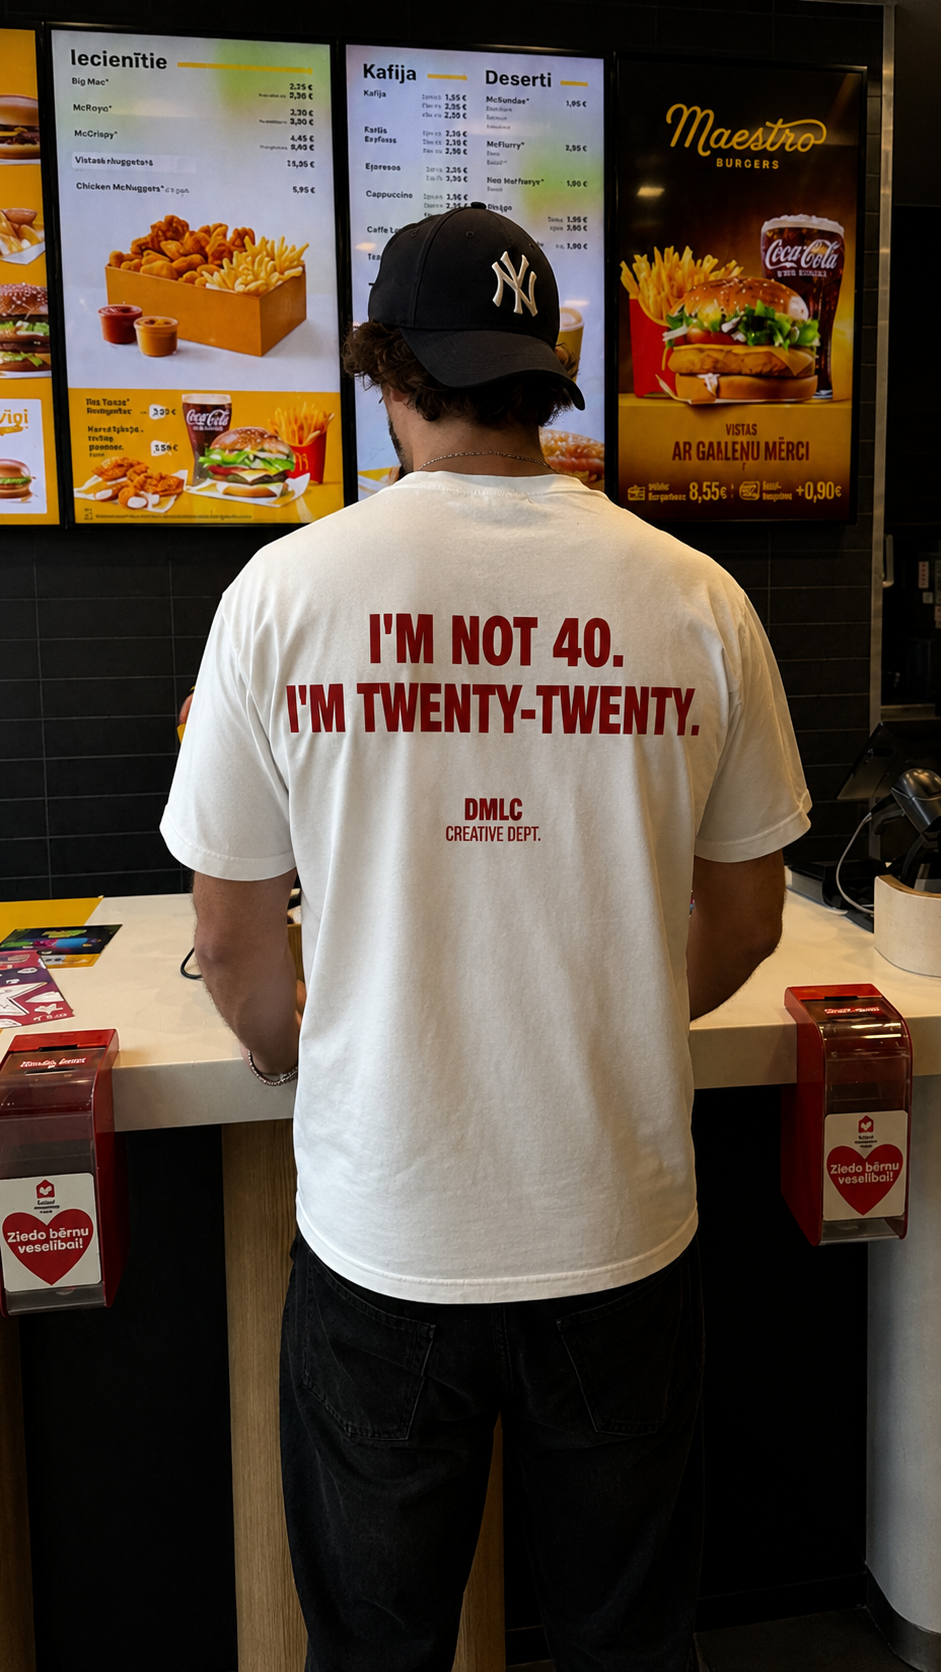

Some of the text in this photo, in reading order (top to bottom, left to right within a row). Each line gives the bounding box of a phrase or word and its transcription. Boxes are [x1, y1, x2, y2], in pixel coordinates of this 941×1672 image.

[71, 49, 167, 69] Iecienītie
[72, 77, 86, 86] Big
[363, 64, 416, 84] Kafija
[486, 70, 552, 88] Deserti
[364, 90, 386, 98] Kafija
[666, 103, 828, 156] Maestro
[716, 158, 780, 169] BURGERS
[76, 182, 110, 191] Chicken
[726, 423, 758, 436] VISTAS
[672, 441, 692, 461] AR
[764, 437, 810, 461] MĒRCI
[370, 613, 624, 668] I'M NOT 40.
[286, 682, 700, 736] I'M TWENTY-TWENTY.
[464, 798, 523, 822] DMLC
[446, 825, 542, 842] CREATIVE DEPT.
[830, 1163, 863, 1174] Ziedo
[7, 1228, 89, 1243] Ziedo bērnu
[18, 1238, 84, 1254] veselībai!
